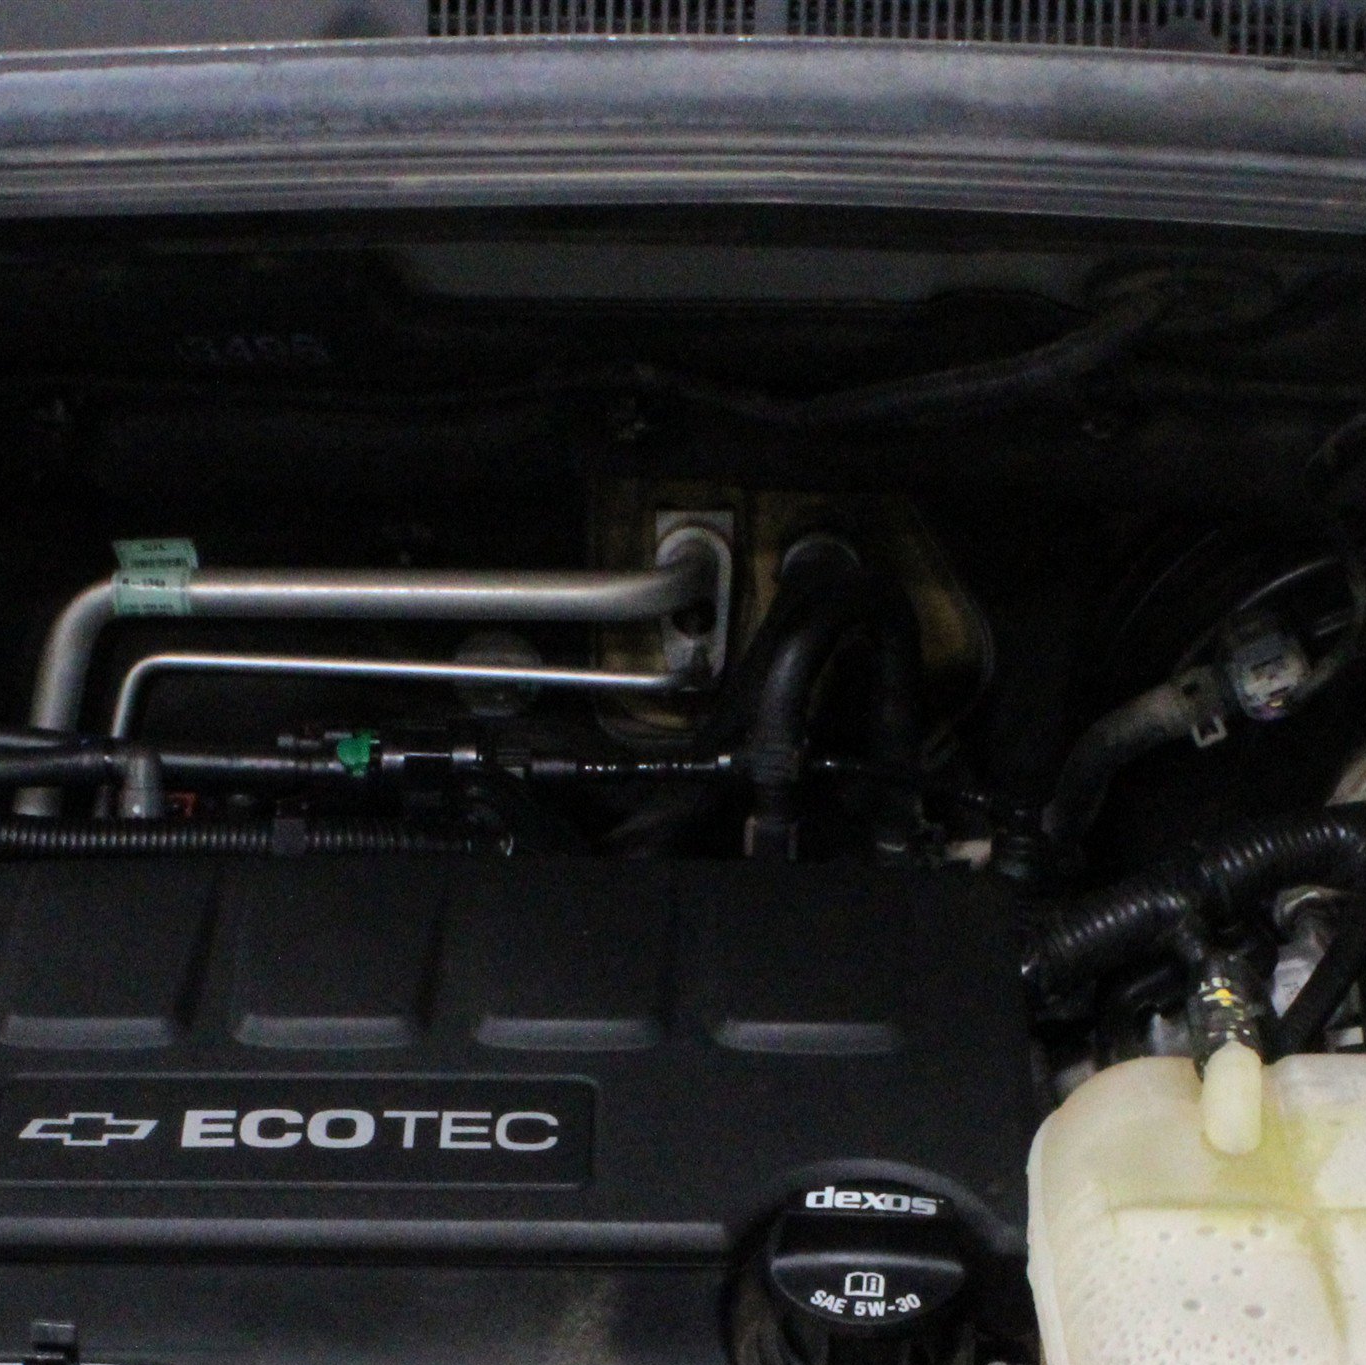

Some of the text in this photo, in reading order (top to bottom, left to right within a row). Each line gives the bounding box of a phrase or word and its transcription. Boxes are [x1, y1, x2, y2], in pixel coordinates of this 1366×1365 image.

[181, 1109, 560, 1151] ECOTEC
[805, 1186, 937, 1215] dexos
[809, 1289, 921, 1317] SAE 5W-30
